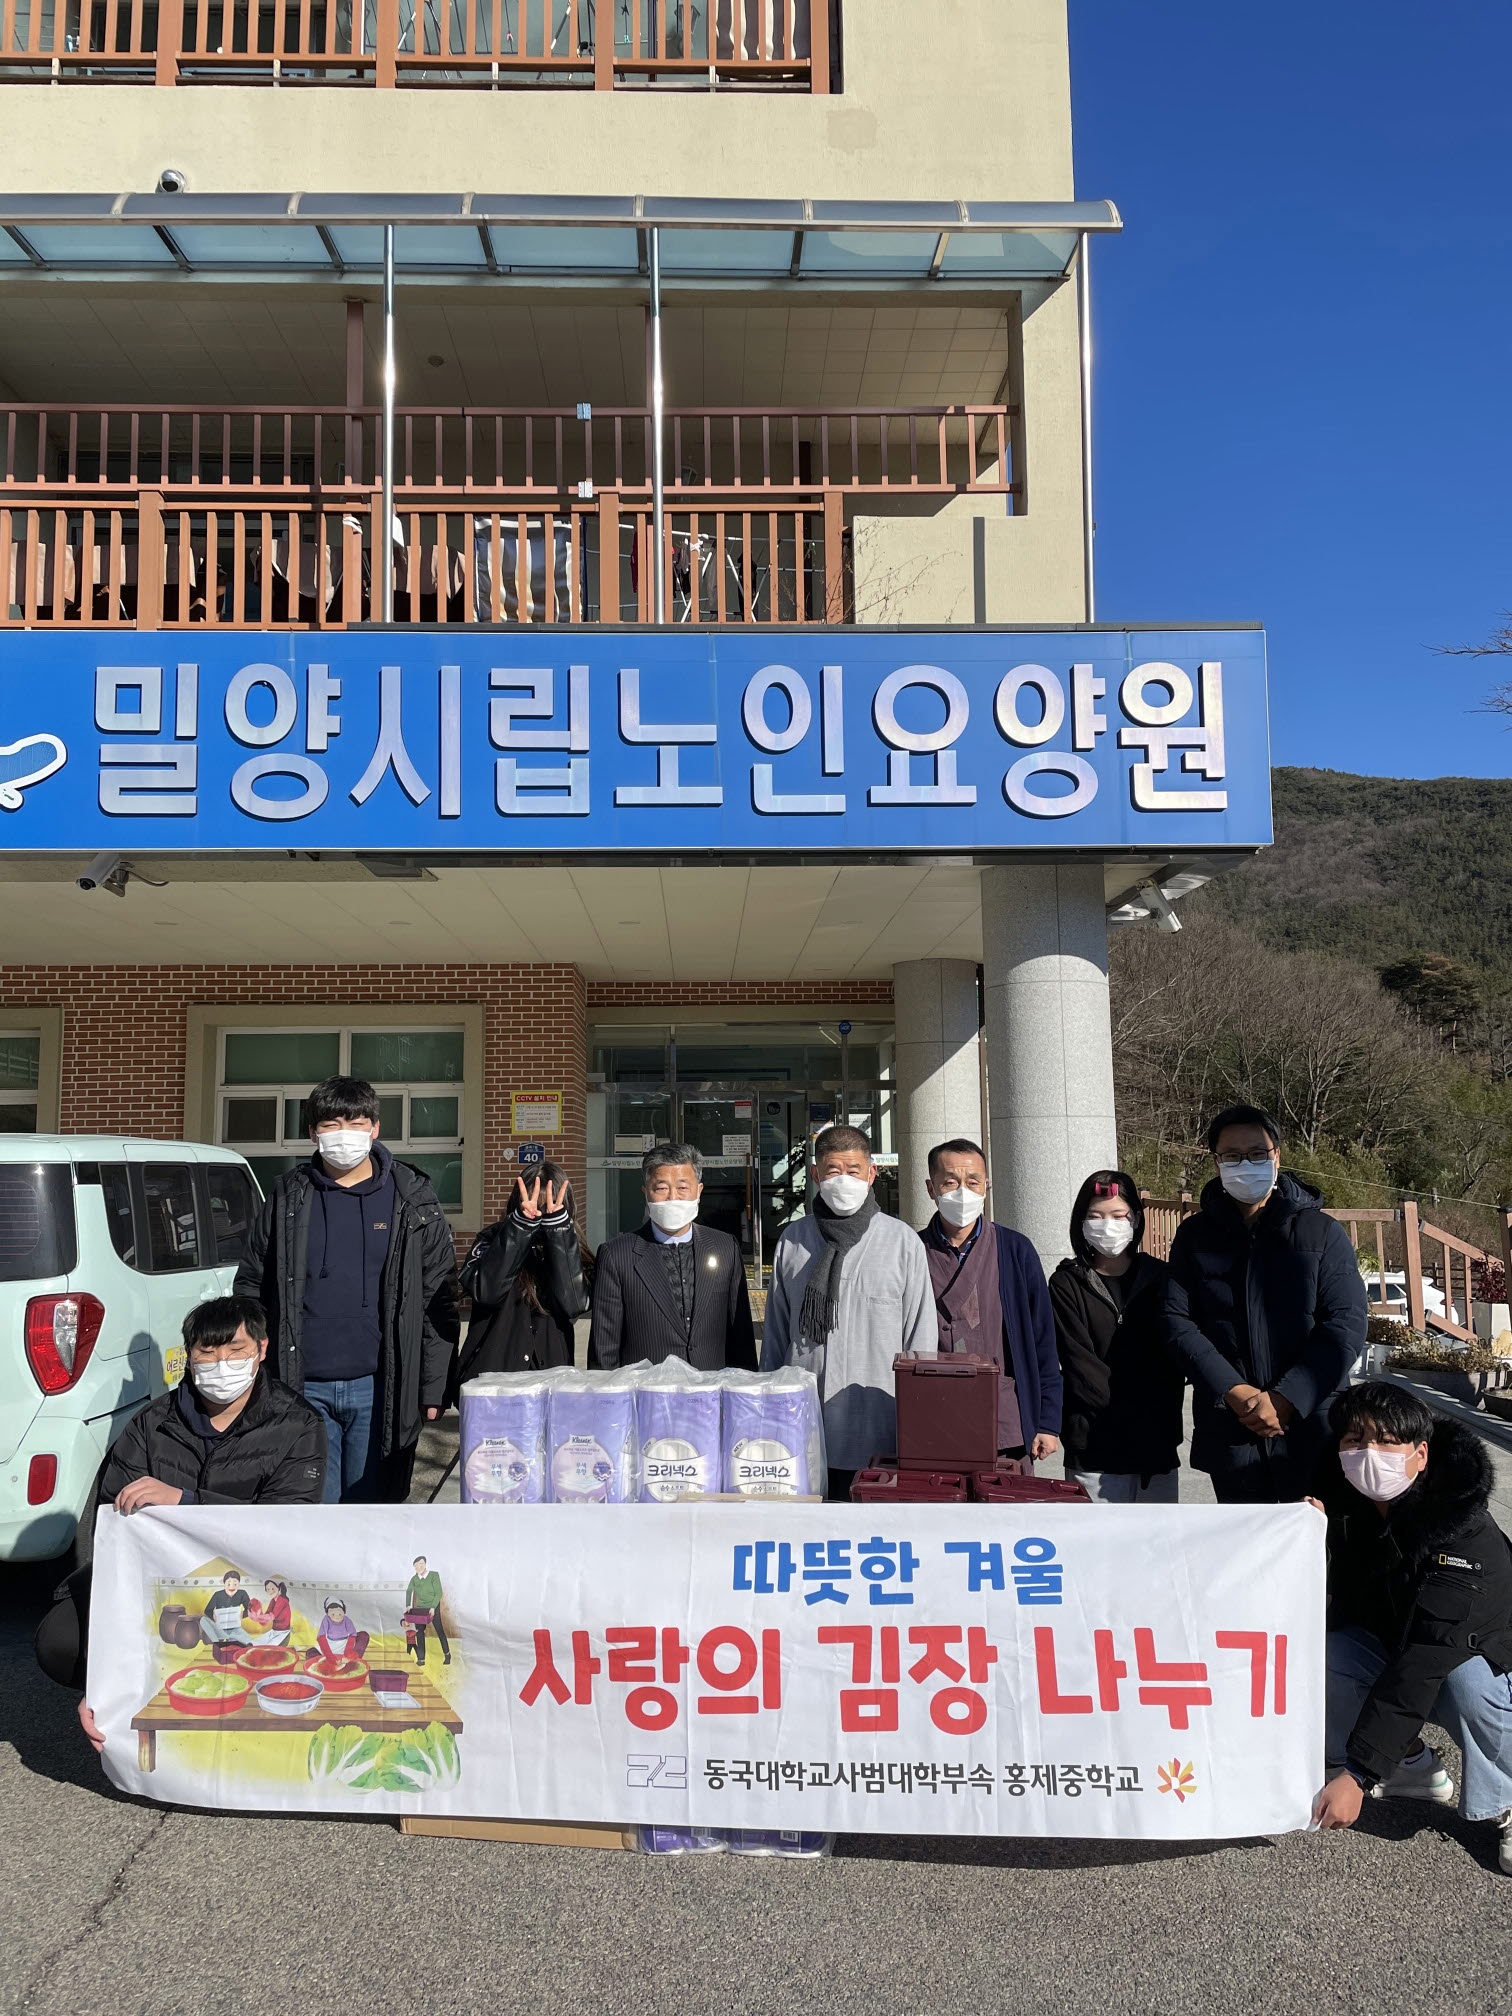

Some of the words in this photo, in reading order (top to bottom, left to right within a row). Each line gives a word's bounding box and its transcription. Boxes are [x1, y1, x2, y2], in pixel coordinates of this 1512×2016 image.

[94, 661, 1228, 821] 밀양시립노인요양원
[523, 1153, 539, 1162] 40
[647, 1464, 698, 1478] 크리넥스
[739, 1464, 791, 1479] 크리넥스
[1446, 1560, 1473, 1570] GEOGRAPHIC
[1447, 1556, 1468, 1565] NATIONAL
[732, 1536, 920, 1606] 따뜻한
[944, 1537, 1064, 1606] 겨울
[518, 1625, 782, 1732] 사랑의
[817, 1625, 999, 1736] 김장
[1033, 1625, 1289, 1731] 나누기
[1003, 1762, 1144, 1797] 홍제중학교
